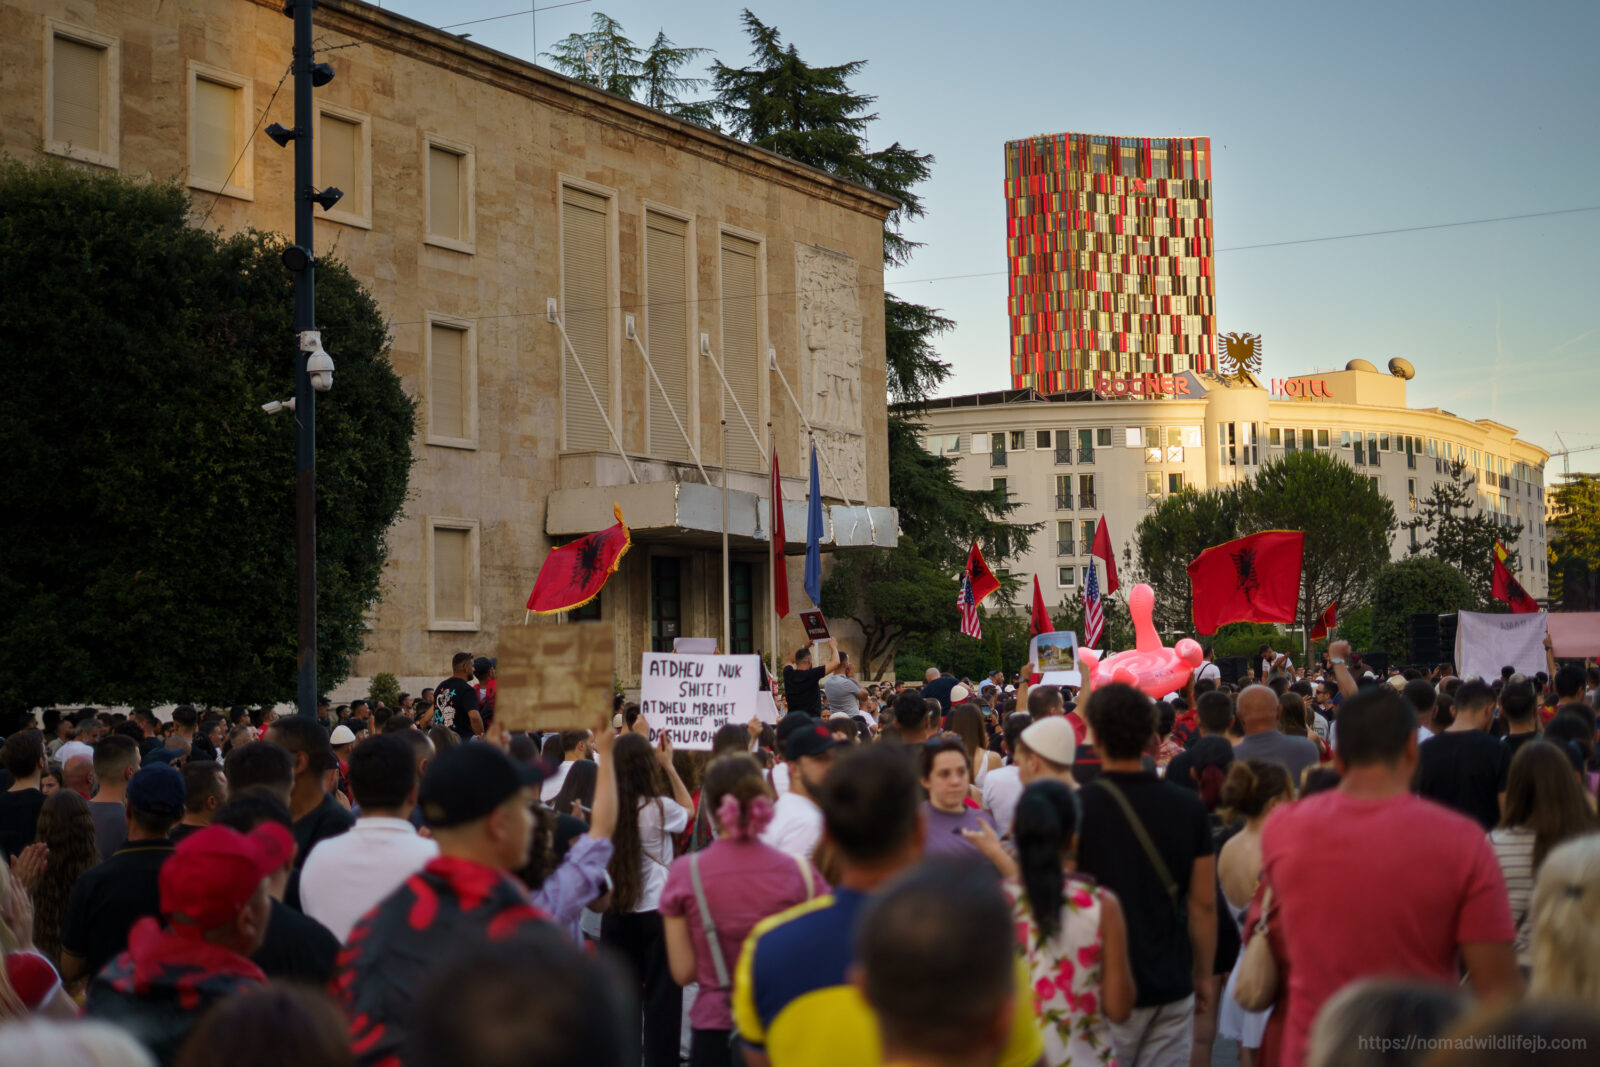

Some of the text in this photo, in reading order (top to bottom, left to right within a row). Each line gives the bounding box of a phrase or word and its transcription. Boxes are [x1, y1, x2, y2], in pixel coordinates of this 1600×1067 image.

[1096, 376, 1334, 398] ROGNER HOTEL
[649, 660, 742, 678] ATDHEU NUK
[642, 700, 736, 715] ATDHEU MBAHET
[666, 716, 704, 725] MBROHET
